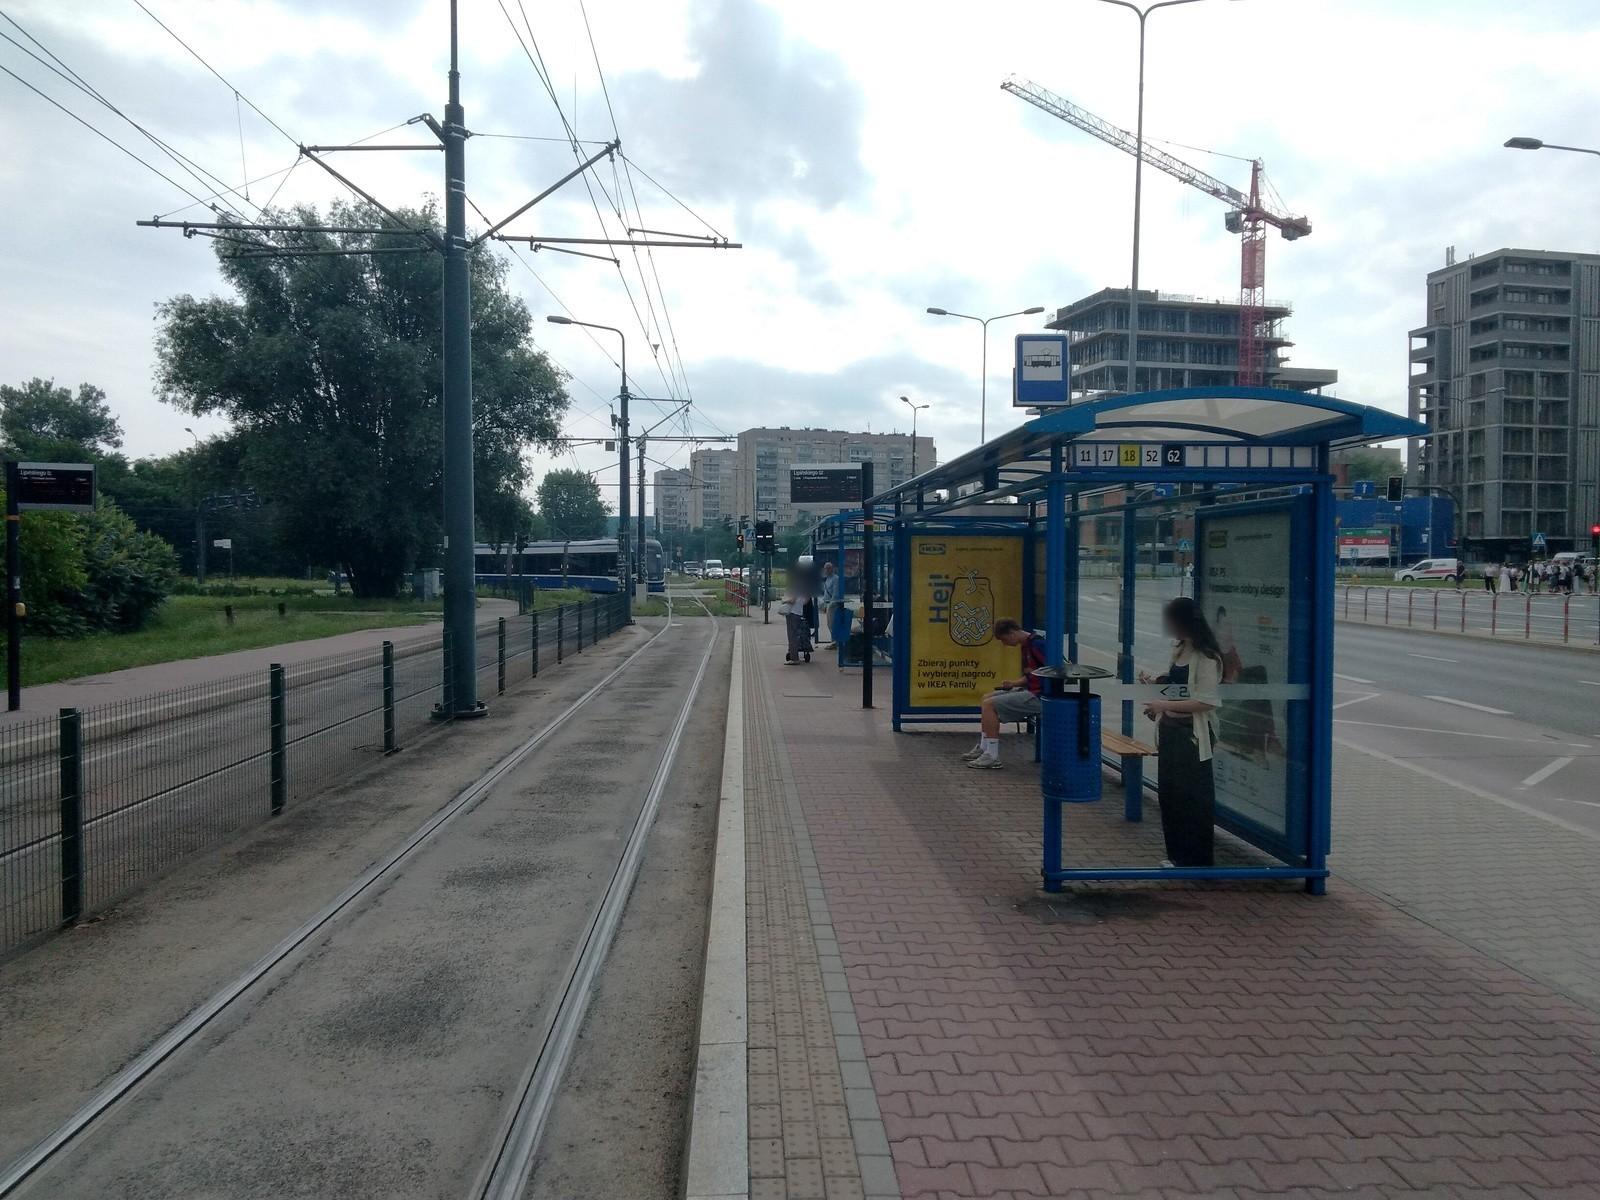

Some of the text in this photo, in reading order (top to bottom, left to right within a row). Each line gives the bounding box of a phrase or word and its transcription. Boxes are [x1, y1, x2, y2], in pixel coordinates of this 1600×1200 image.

[1080, 450, 1180, 462] 11 17 18 52 62
[928, 574, 955, 623] Hej!
[918, 659, 980, 669] Zbieraj punkty
[922, 670, 959, 679] wybieraj
[961, 670, 996, 679] nagrody
[927, 681, 947, 689] IKEA
[949, 680, 977, 690] Family
